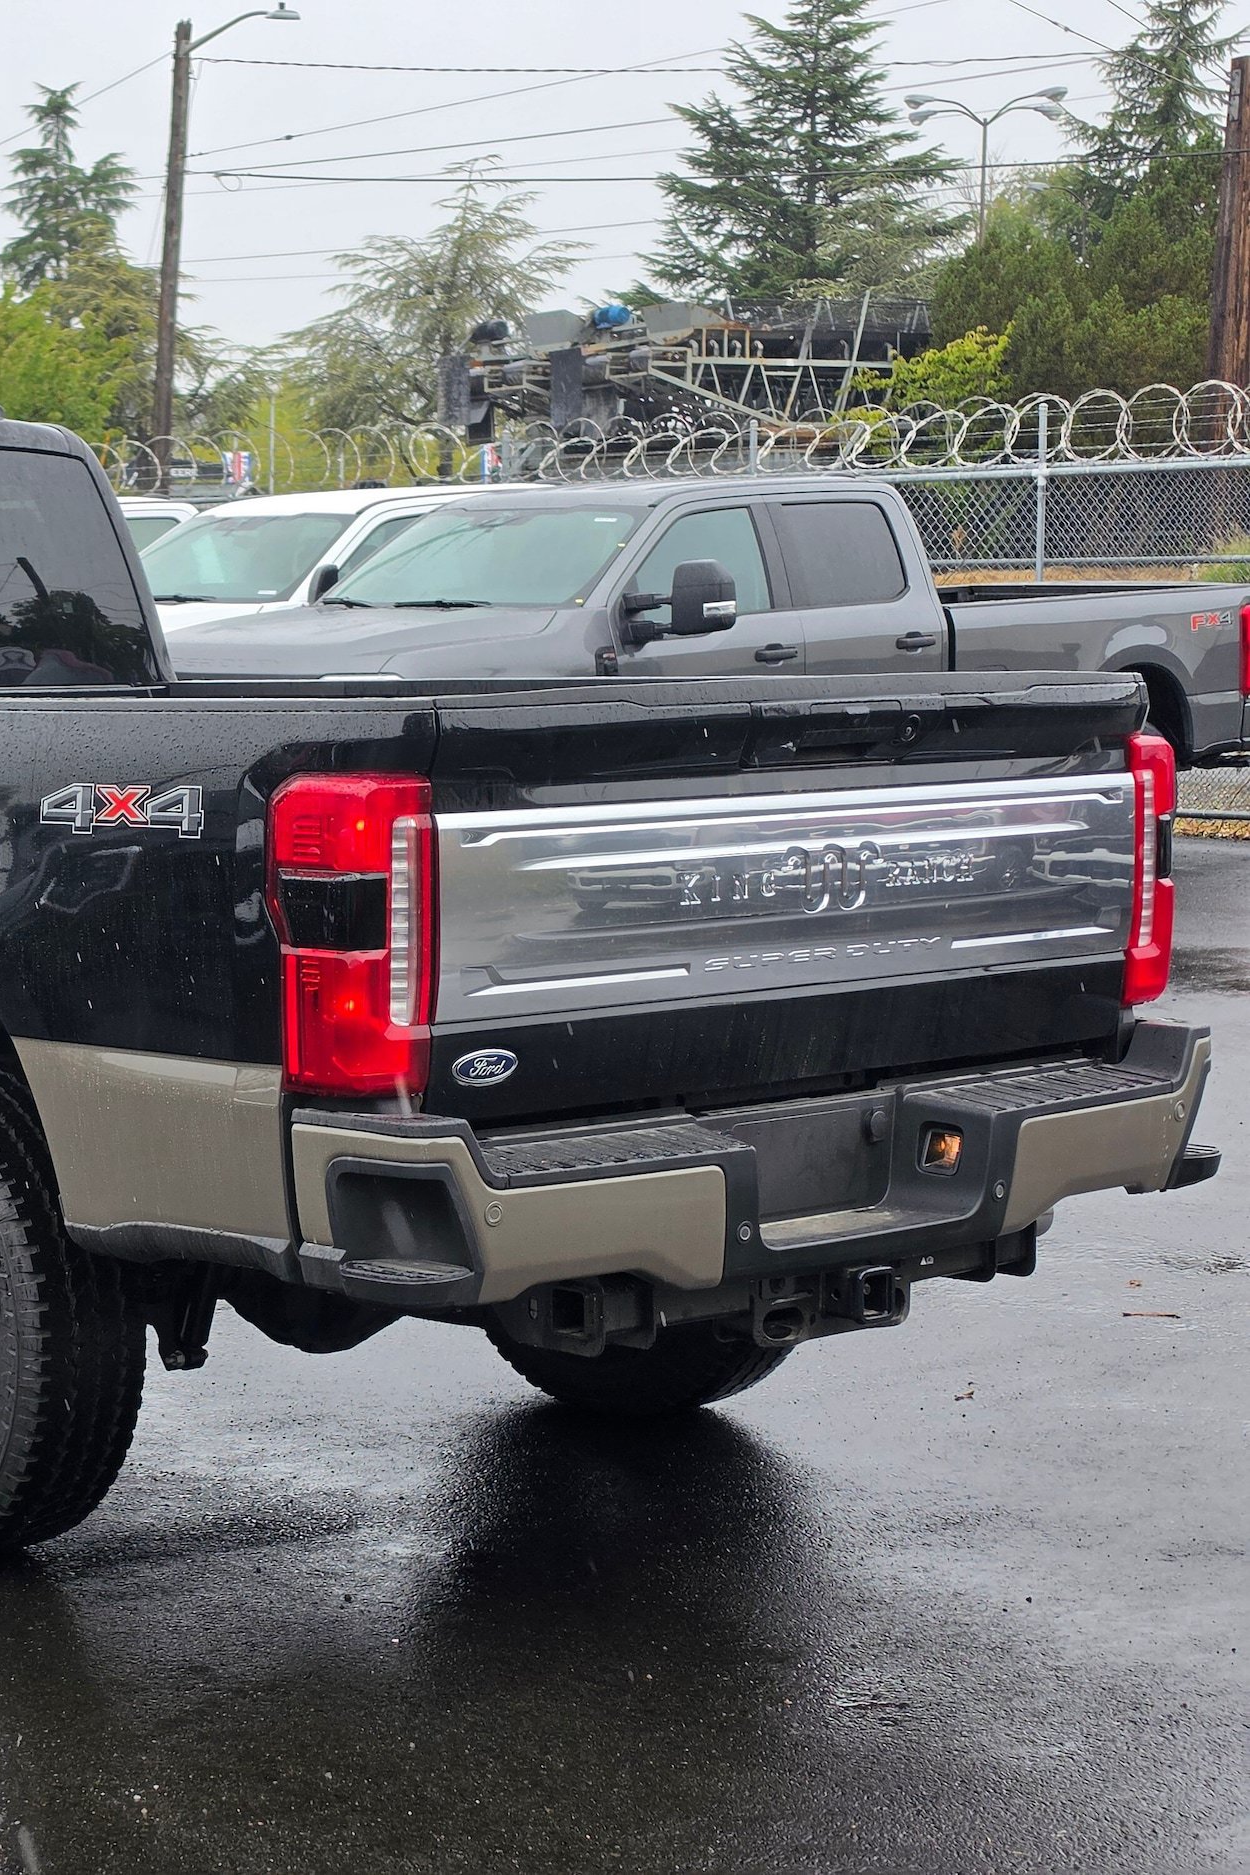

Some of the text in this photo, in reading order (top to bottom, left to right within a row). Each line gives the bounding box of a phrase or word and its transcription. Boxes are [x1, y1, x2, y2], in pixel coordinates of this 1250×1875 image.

[1191, 610, 1232, 633] FX4
[40, 783, 204, 839] 4X4
[679, 852, 974, 906] KING RANCH
[704, 936, 941, 972] SUPER DUTY
[469, 1056, 507, 1077] Ford
